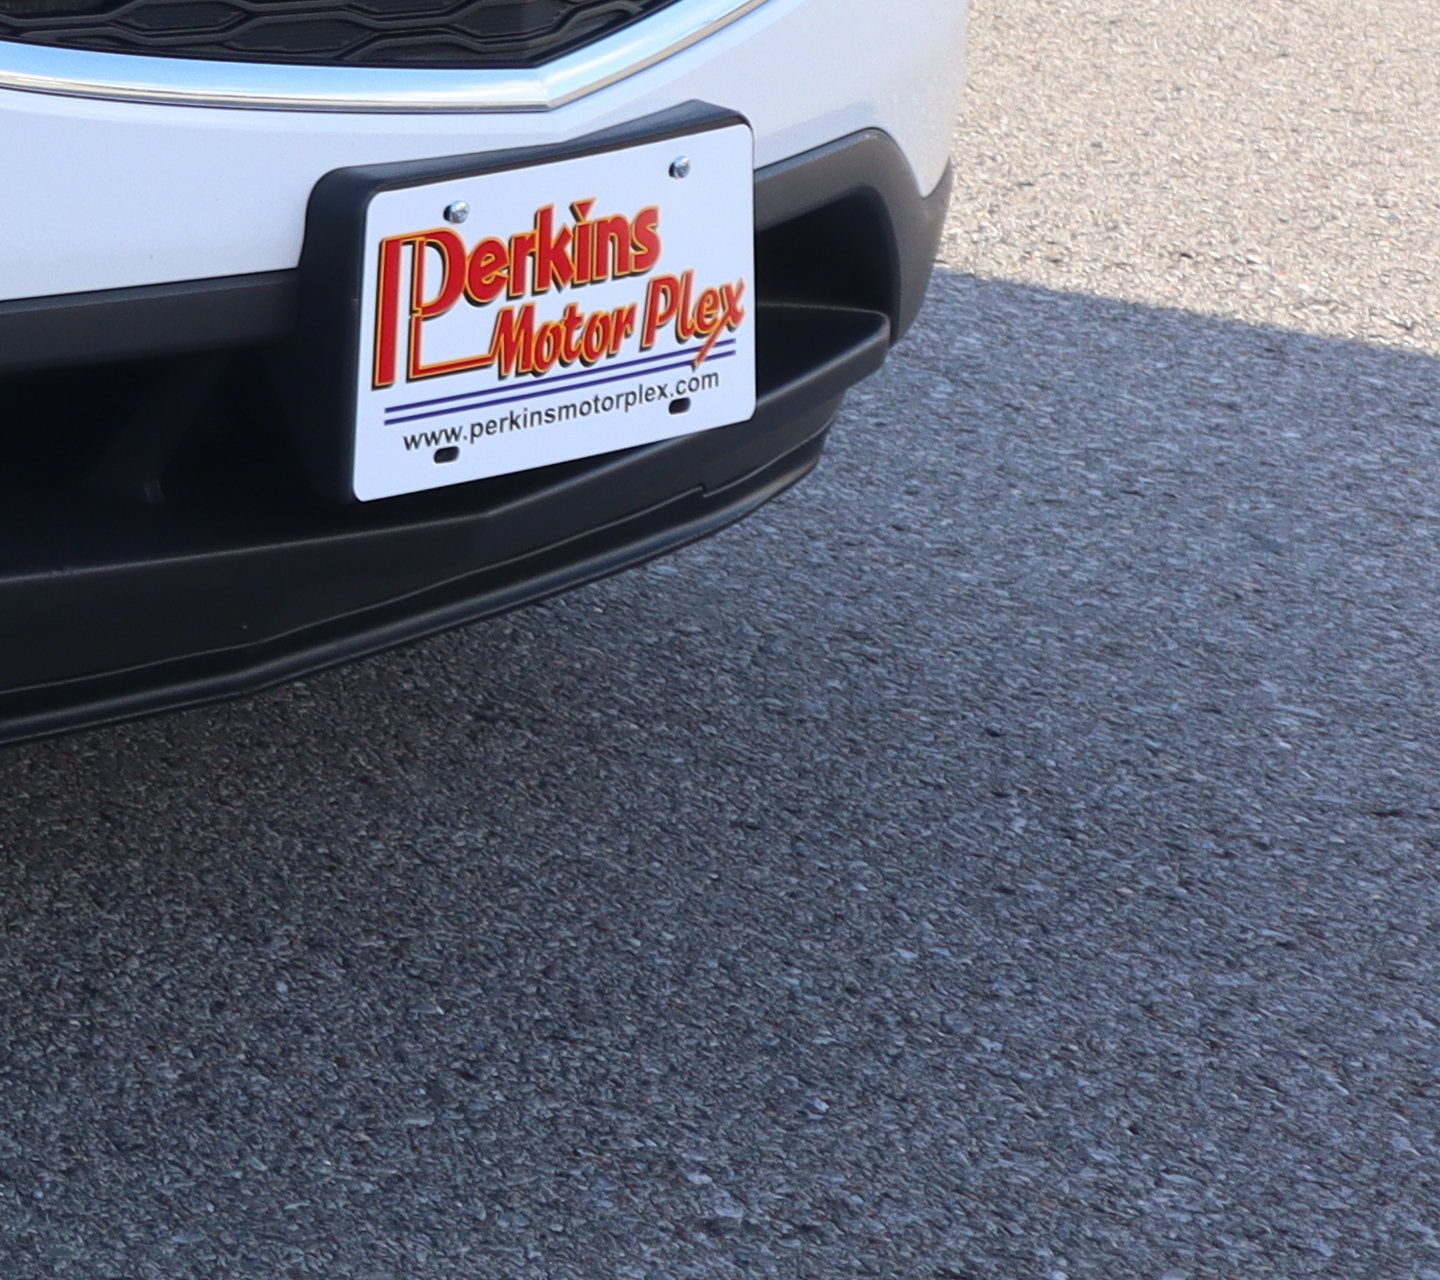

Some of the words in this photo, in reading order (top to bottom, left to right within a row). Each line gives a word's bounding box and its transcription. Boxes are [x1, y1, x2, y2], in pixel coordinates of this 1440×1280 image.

[372, 199, 661, 388] Perkins
[489, 300, 637, 378] Motor
[641, 269, 745, 370] Plex
[403, 369, 720, 451] www.perkinsmotorplex.com
